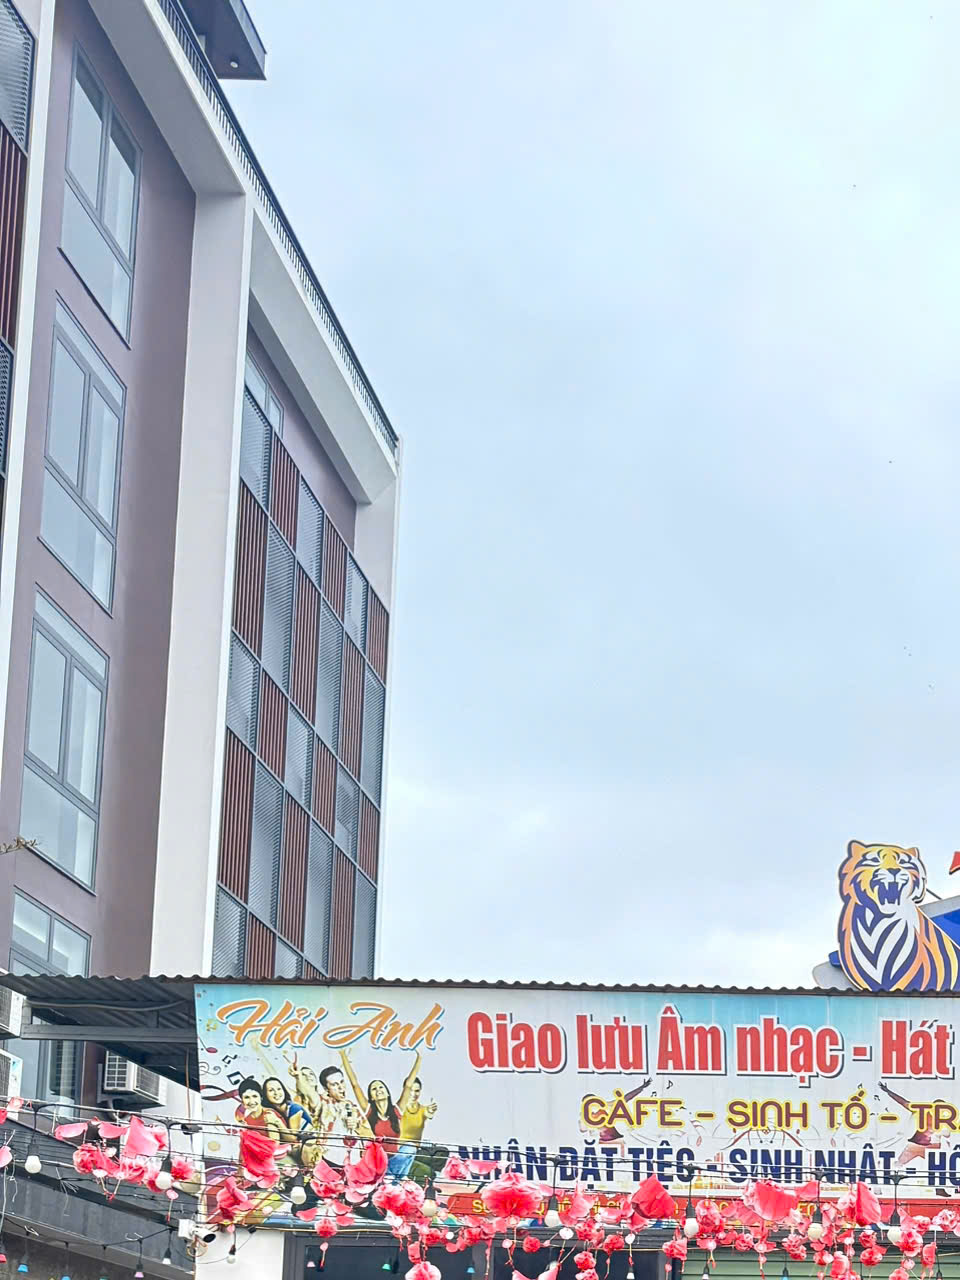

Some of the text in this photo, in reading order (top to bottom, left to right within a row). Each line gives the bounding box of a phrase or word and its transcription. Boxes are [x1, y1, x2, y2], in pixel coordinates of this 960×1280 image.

[216, 999, 443, 1050] Hải Anh
[466, 1010, 565, 1072] Giao
[576, 1014, 646, 1072] lưu
[656, 1005, 724, 1073] Âm
[736, 1017, 841, 1084] nhạc
[881, 1019, 952, 1076] Hát
[727, 1100, 809, 1129] SINH
[821, 1088, 869, 1131] TỐ
[729, 1149, 802, 1184] SINH
